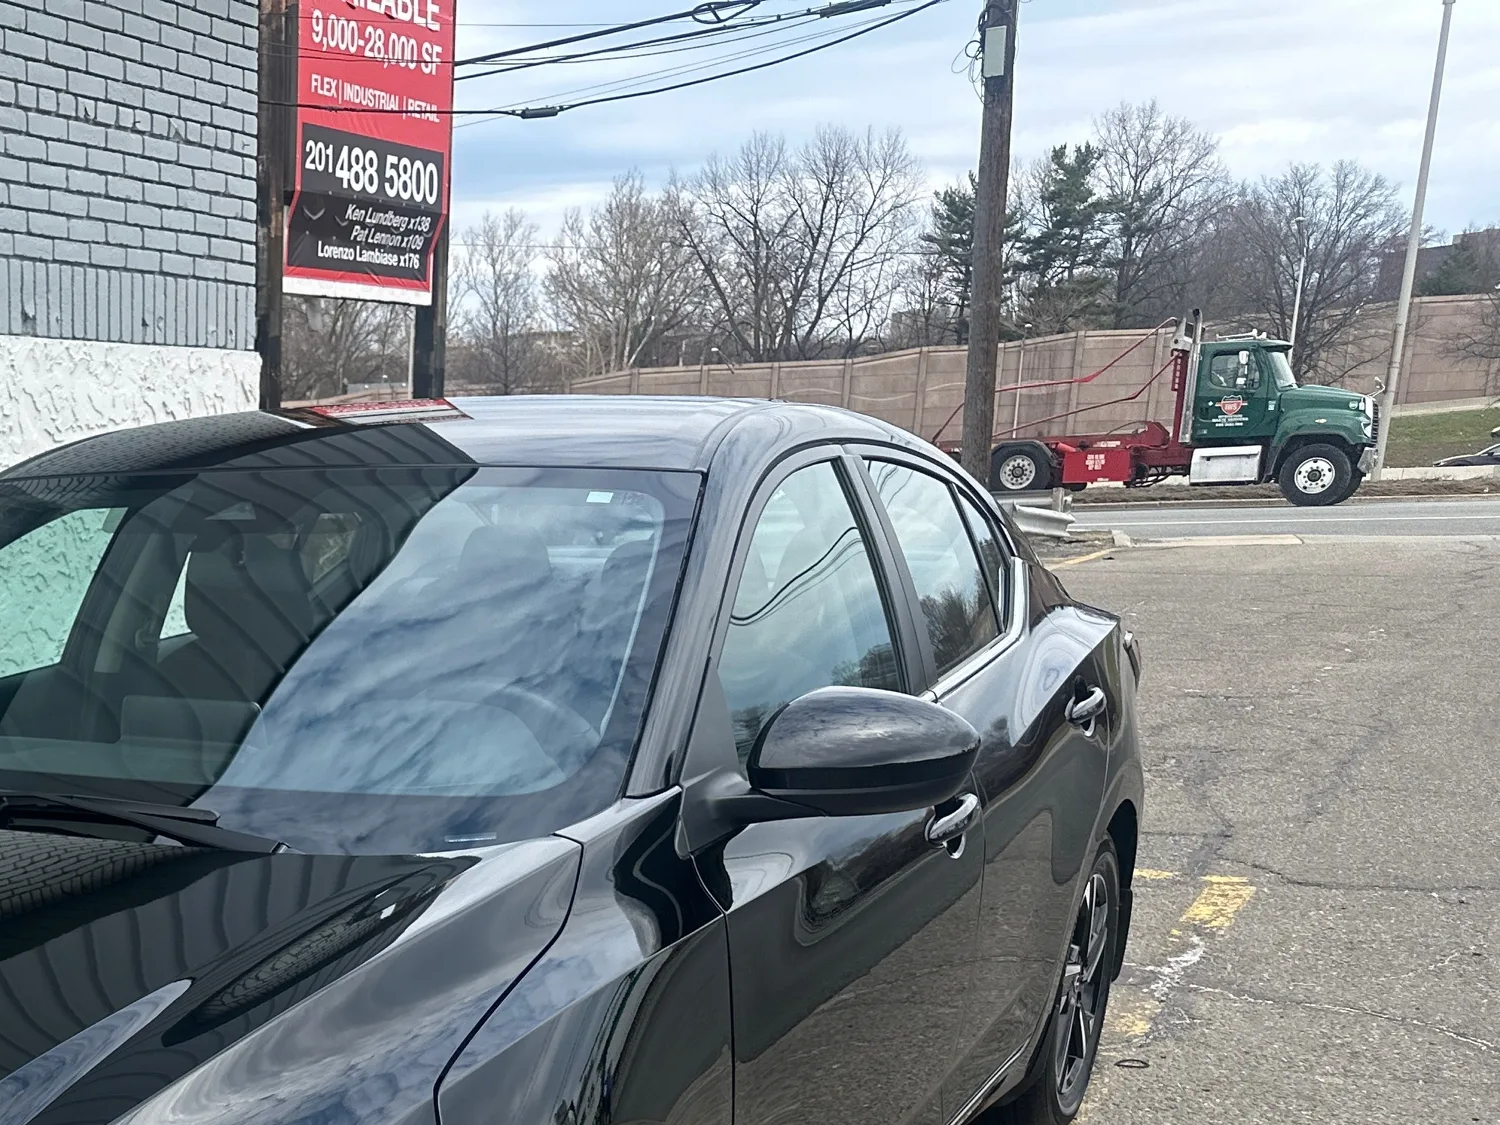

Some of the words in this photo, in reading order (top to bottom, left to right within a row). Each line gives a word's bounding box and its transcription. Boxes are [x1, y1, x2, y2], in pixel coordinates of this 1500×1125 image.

[312, 9, 417, 69] 9,000-28,000
[421, 42, 443, 75] SF
[311, 74, 337, 98] FLEX
[344, 82, 399, 111] INDUSTRIAL
[407, 99, 440, 123] RETAIL
[384, 154, 438, 204] 5800
[345, 204, 366, 222] Ken
[365, 207, 409, 231] Lundberg
[407, 216, 431, 232] x138
[318, 241, 354, 260] Lorenzo
[356, 245, 399, 266] Lambiase
[399, 253, 420, 269] x176
[350, 225, 368, 242] Pat
[368, 228, 402, 247] Lennon
[401, 234, 424, 250] x109
